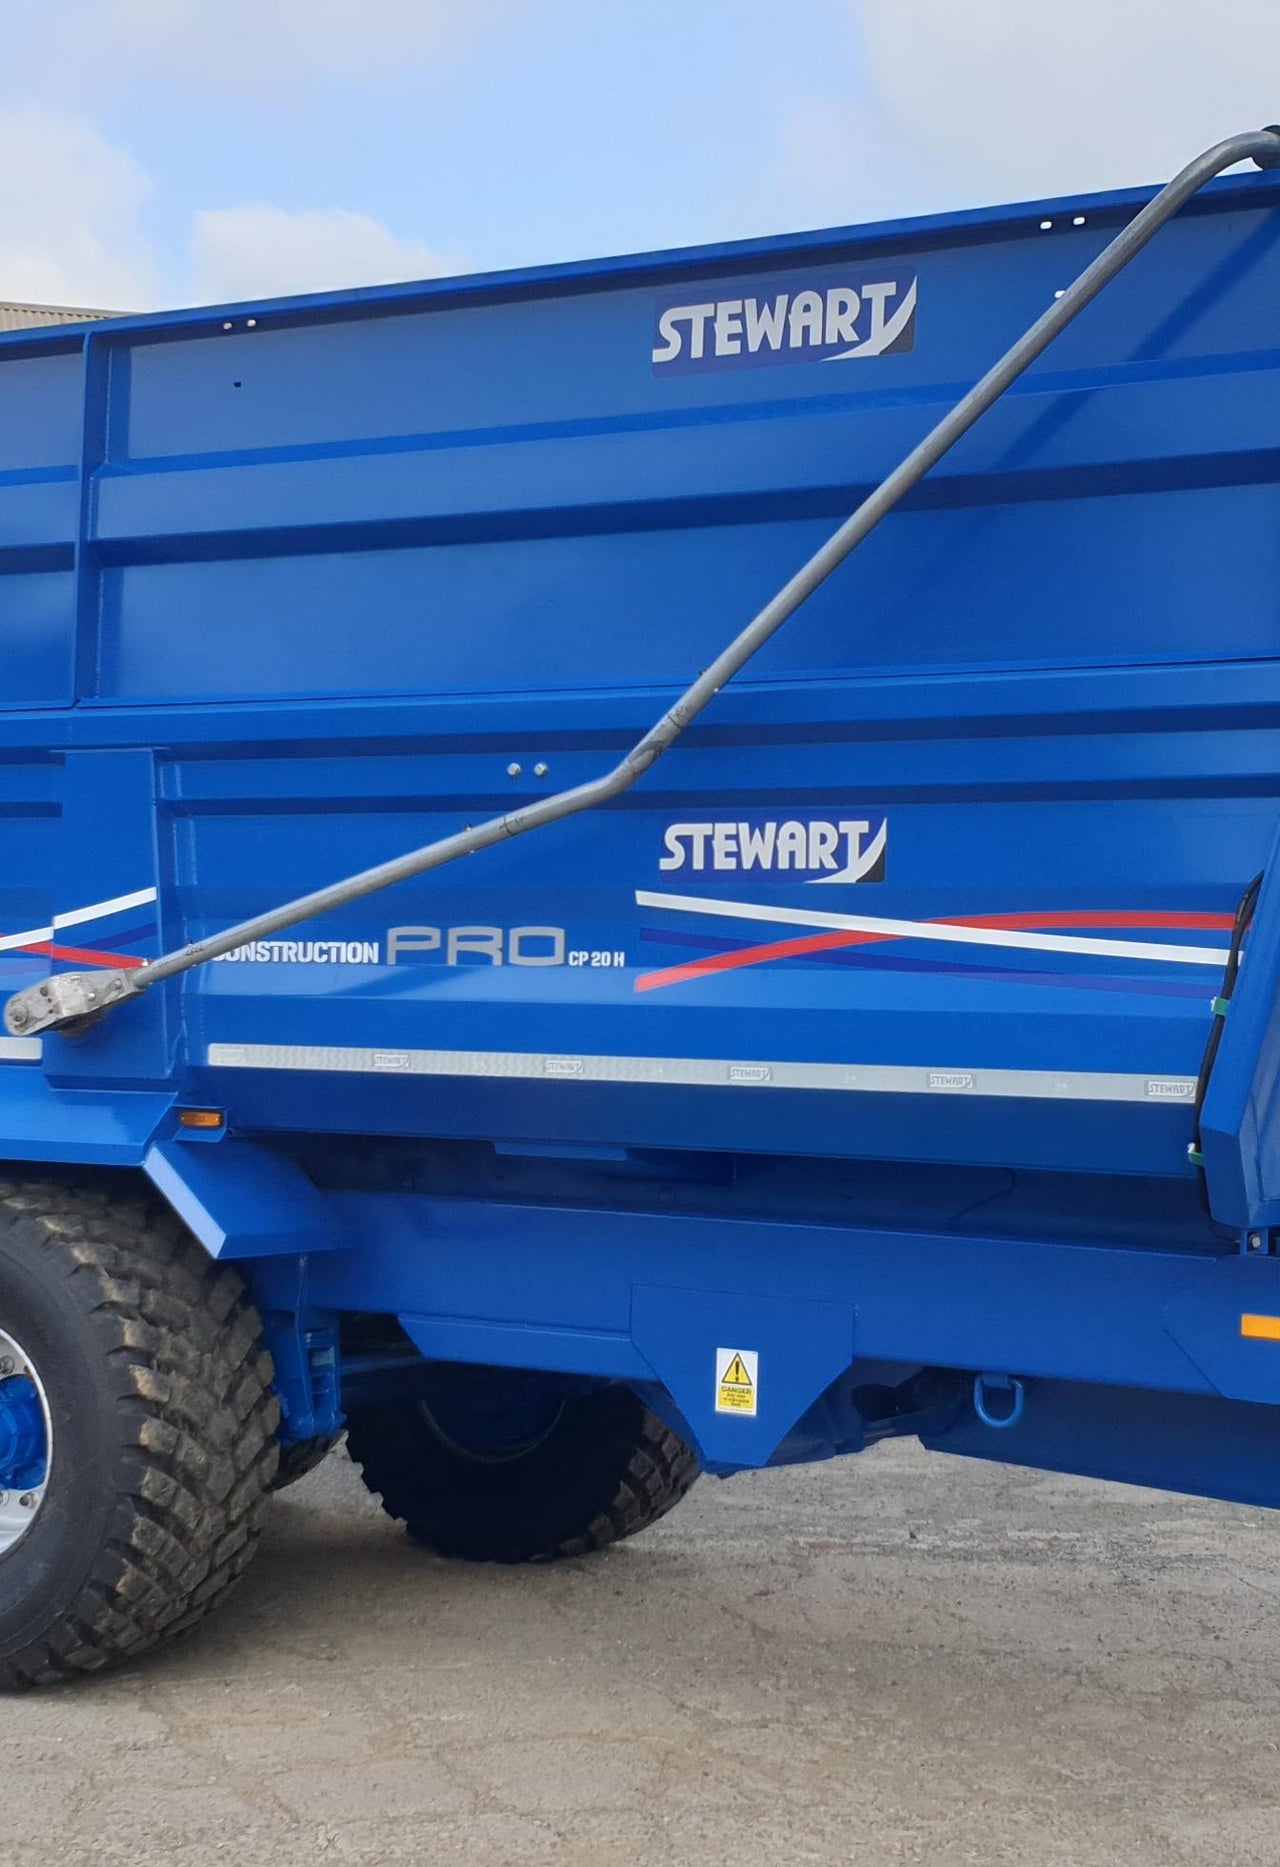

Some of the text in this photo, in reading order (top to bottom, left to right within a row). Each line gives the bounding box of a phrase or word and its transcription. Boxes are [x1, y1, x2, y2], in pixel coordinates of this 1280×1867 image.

[652, 275, 917, 362] STEWART
[659, 817, 887, 884] STEWART
[213, 926, 625, 967] ONSTRUCTION PRO CP 20 H
